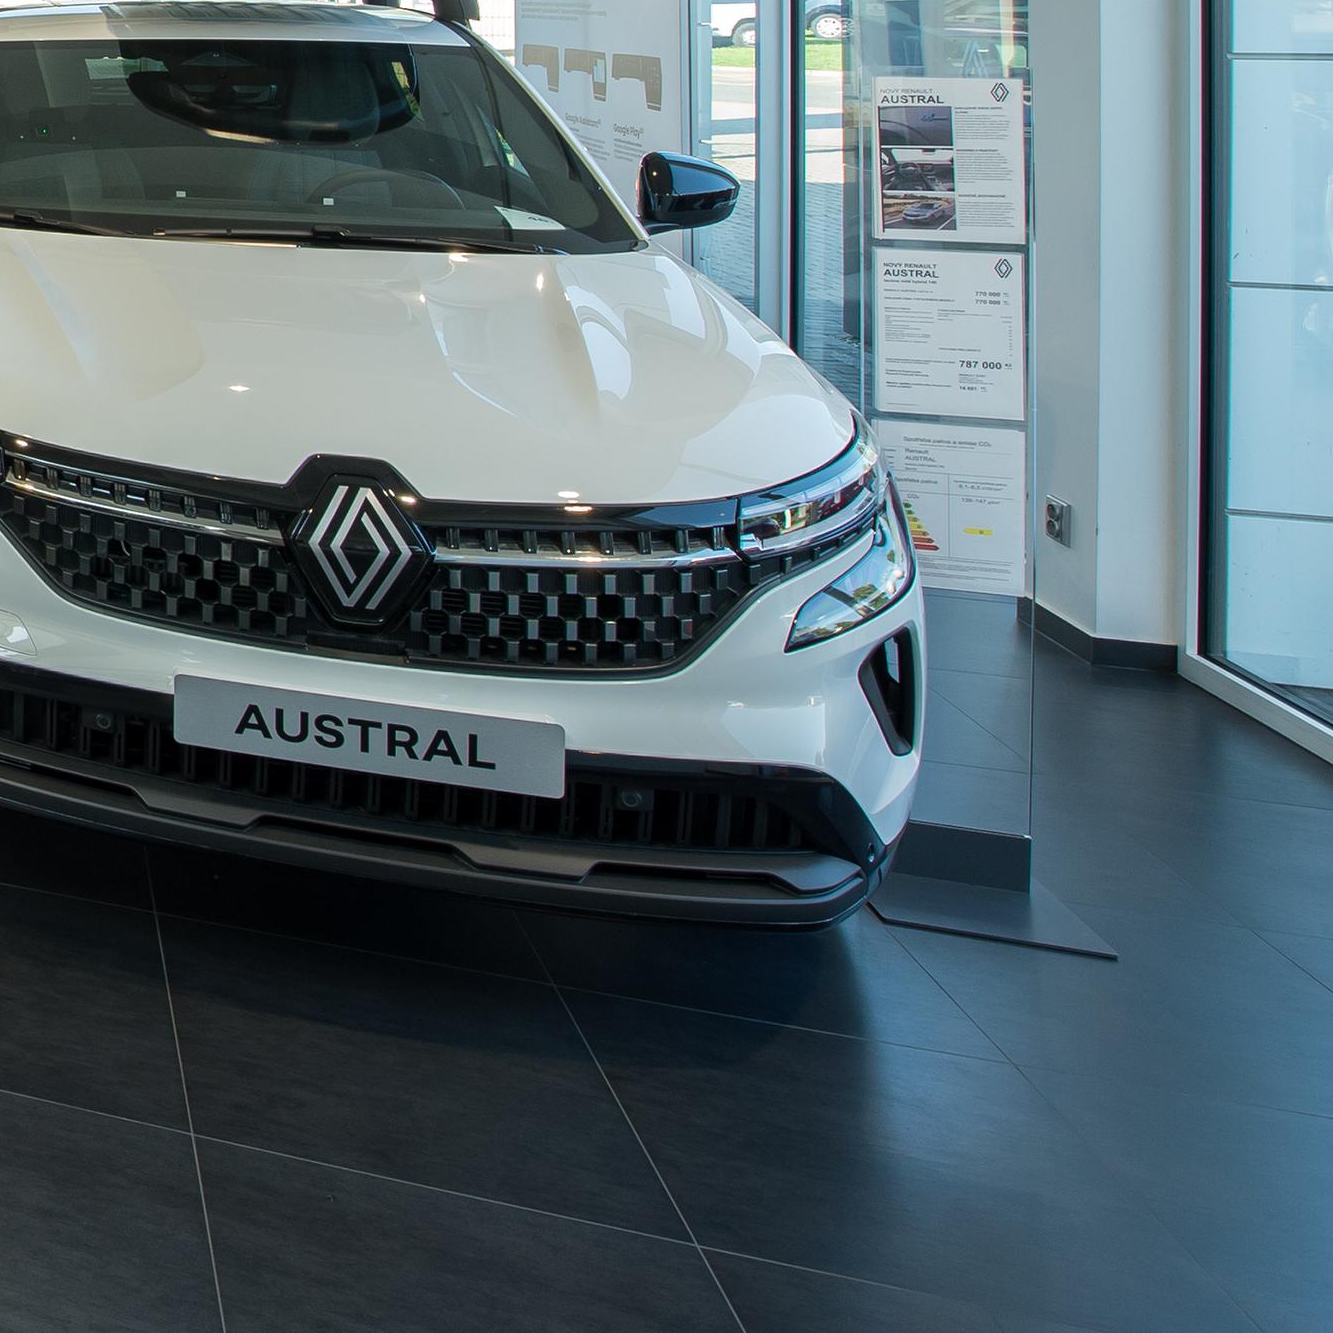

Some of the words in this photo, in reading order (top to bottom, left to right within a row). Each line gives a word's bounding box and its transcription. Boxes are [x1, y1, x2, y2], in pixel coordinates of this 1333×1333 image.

[881, 95, 944, 104] AUSTRAL
[884, 269, 939, 278] AUSTRAL
[959, 360, 978, 368] 787
[982, 361, 1002, 369] 000
[235, 704, 497, 771] AUSTRAL
